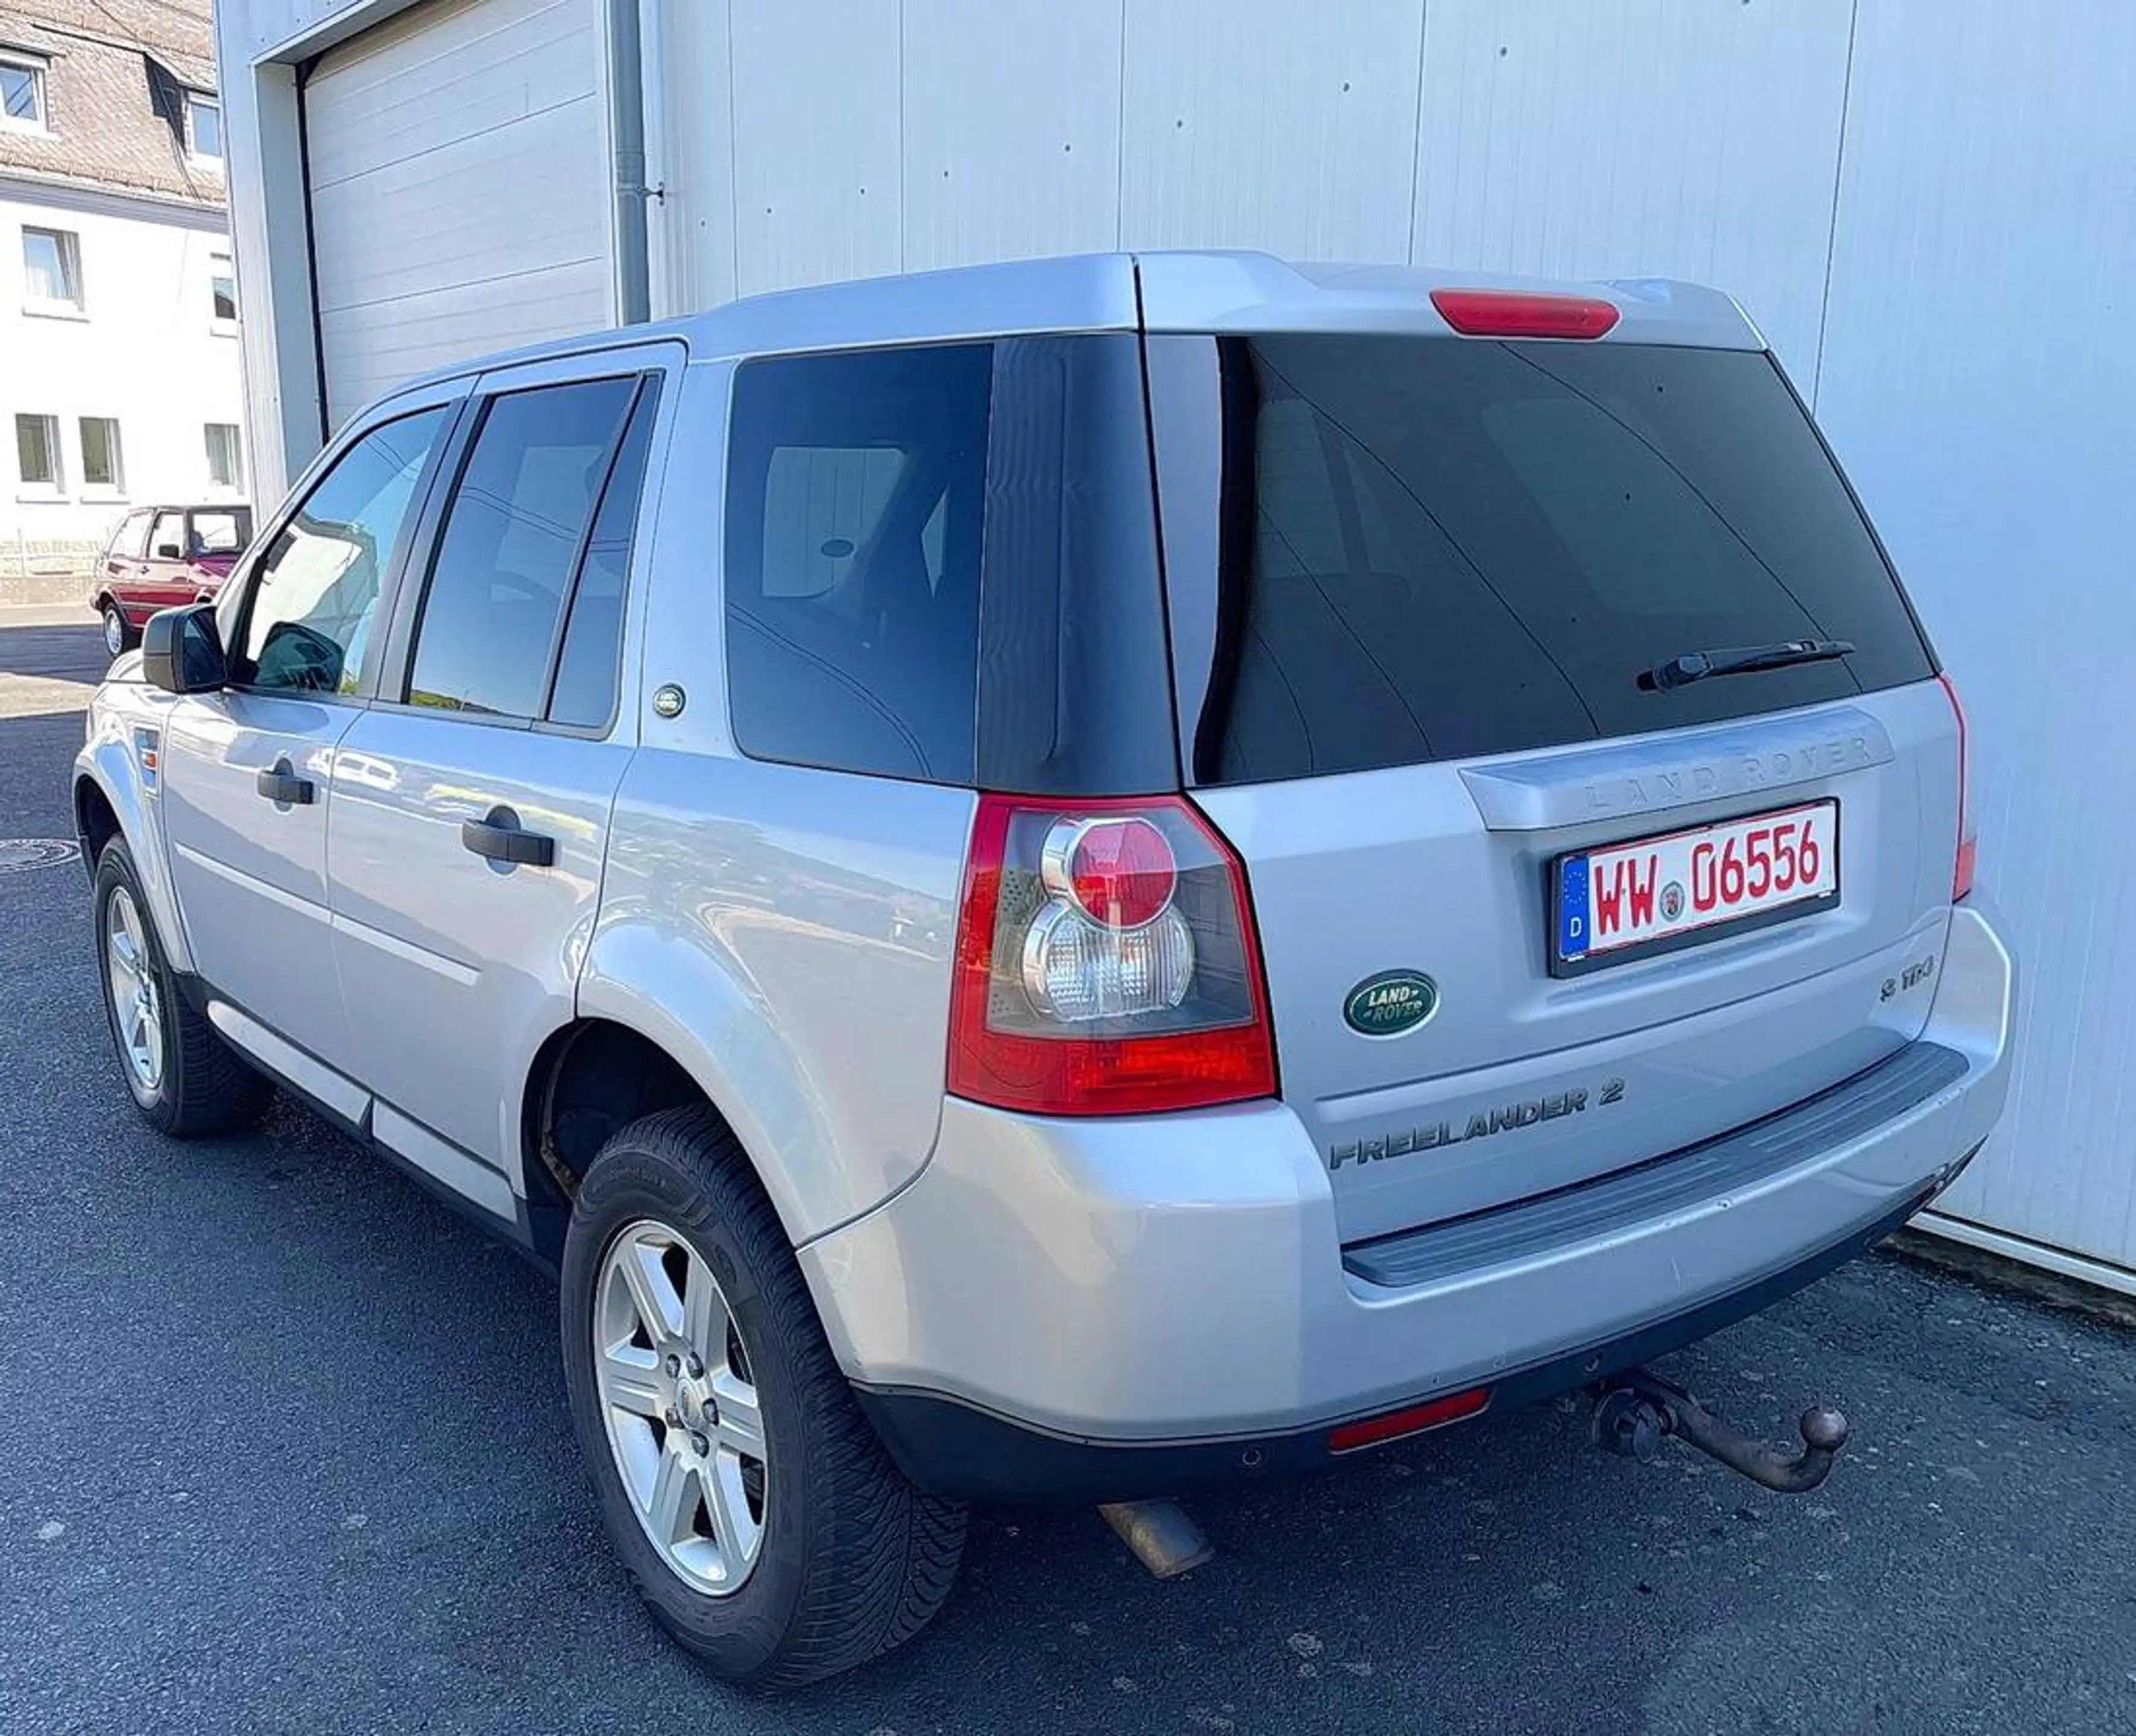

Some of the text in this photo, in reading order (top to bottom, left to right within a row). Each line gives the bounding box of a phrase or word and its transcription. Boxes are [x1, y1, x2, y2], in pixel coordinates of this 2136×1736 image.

[1584, 737, 1871, 809] LAND ROVER
[1594, 820, 1819, 936] WW 06556
[1569, 917, 1583, 937] D
[1329, 1075, 1626, 1170] FREELANDER 2
